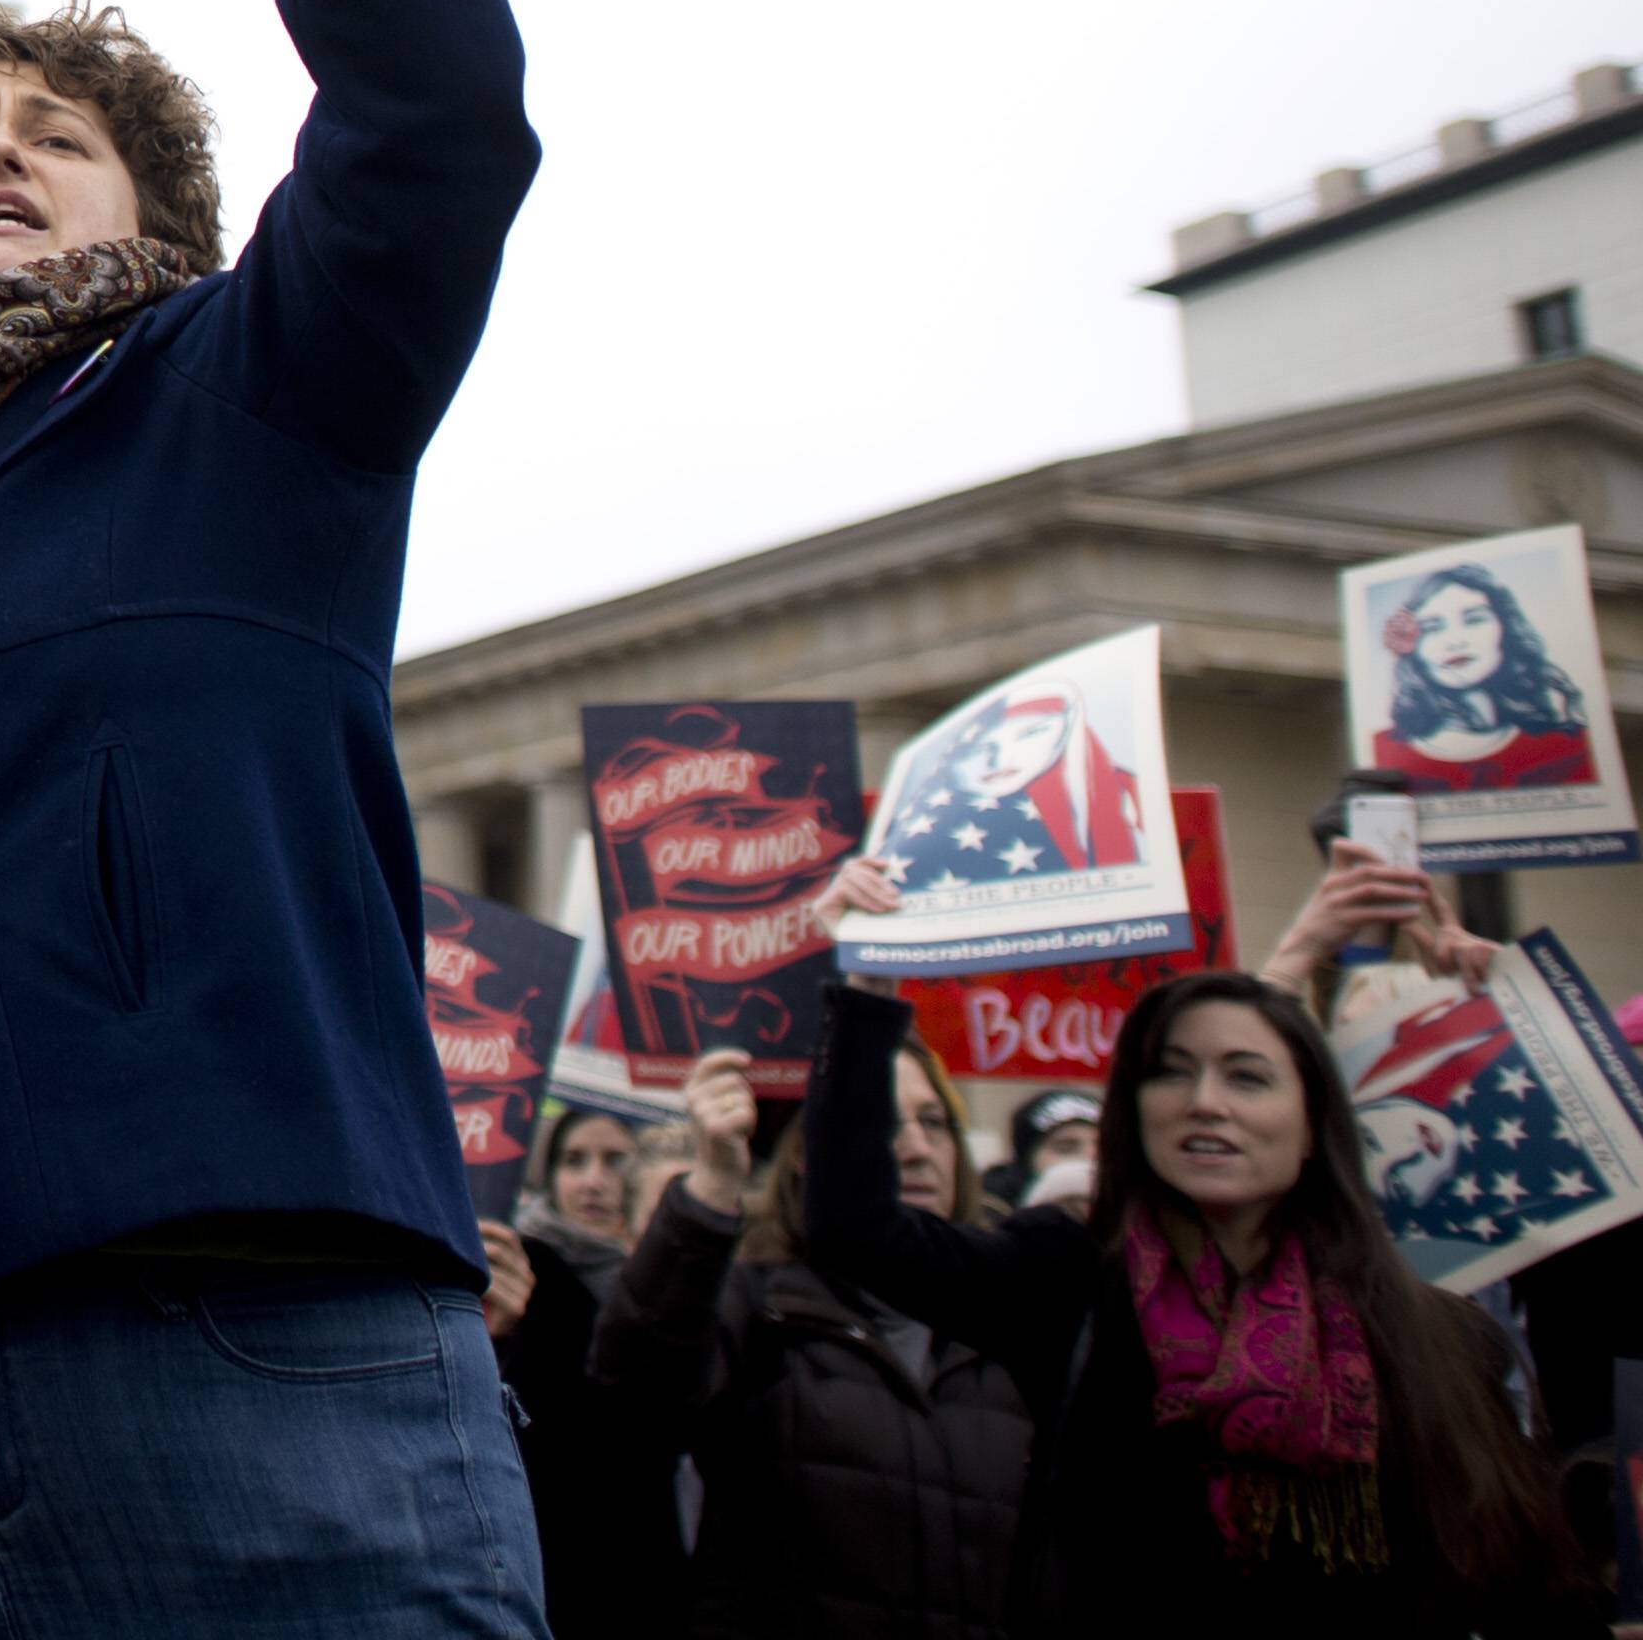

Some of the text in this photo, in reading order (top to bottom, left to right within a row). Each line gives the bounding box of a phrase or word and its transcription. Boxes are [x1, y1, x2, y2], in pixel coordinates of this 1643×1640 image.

[603, 751, 756, 825] OUR BODIES
[655, 817, 822, 876] OUR MINDS
[953, 888, 1002, 906] THE
[1013, 872, 1114, 900] PEOPLE
[628, 918, 702, 965] OUR
[859, 920, 1169, 962] democratsabroad.org/join
